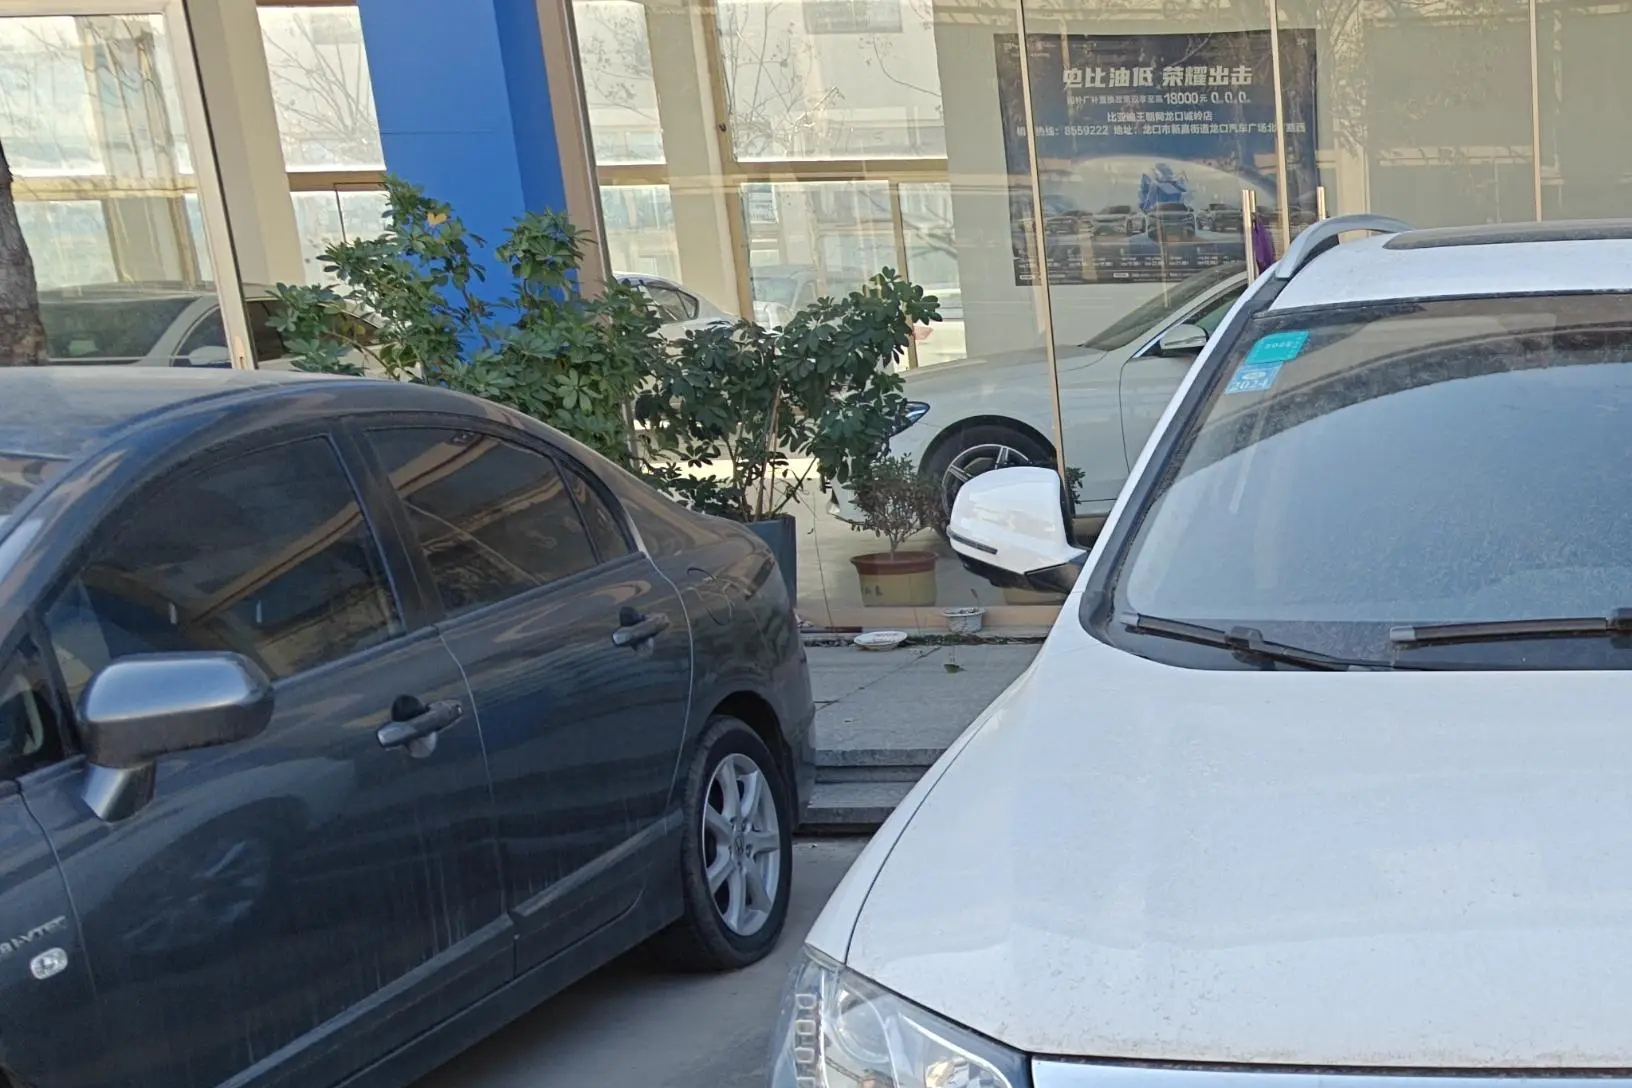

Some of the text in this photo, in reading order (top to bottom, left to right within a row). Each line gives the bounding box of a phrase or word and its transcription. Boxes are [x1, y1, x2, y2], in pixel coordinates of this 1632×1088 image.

[1063, 65, 1253, 88] 电比油低 荣耀出击
